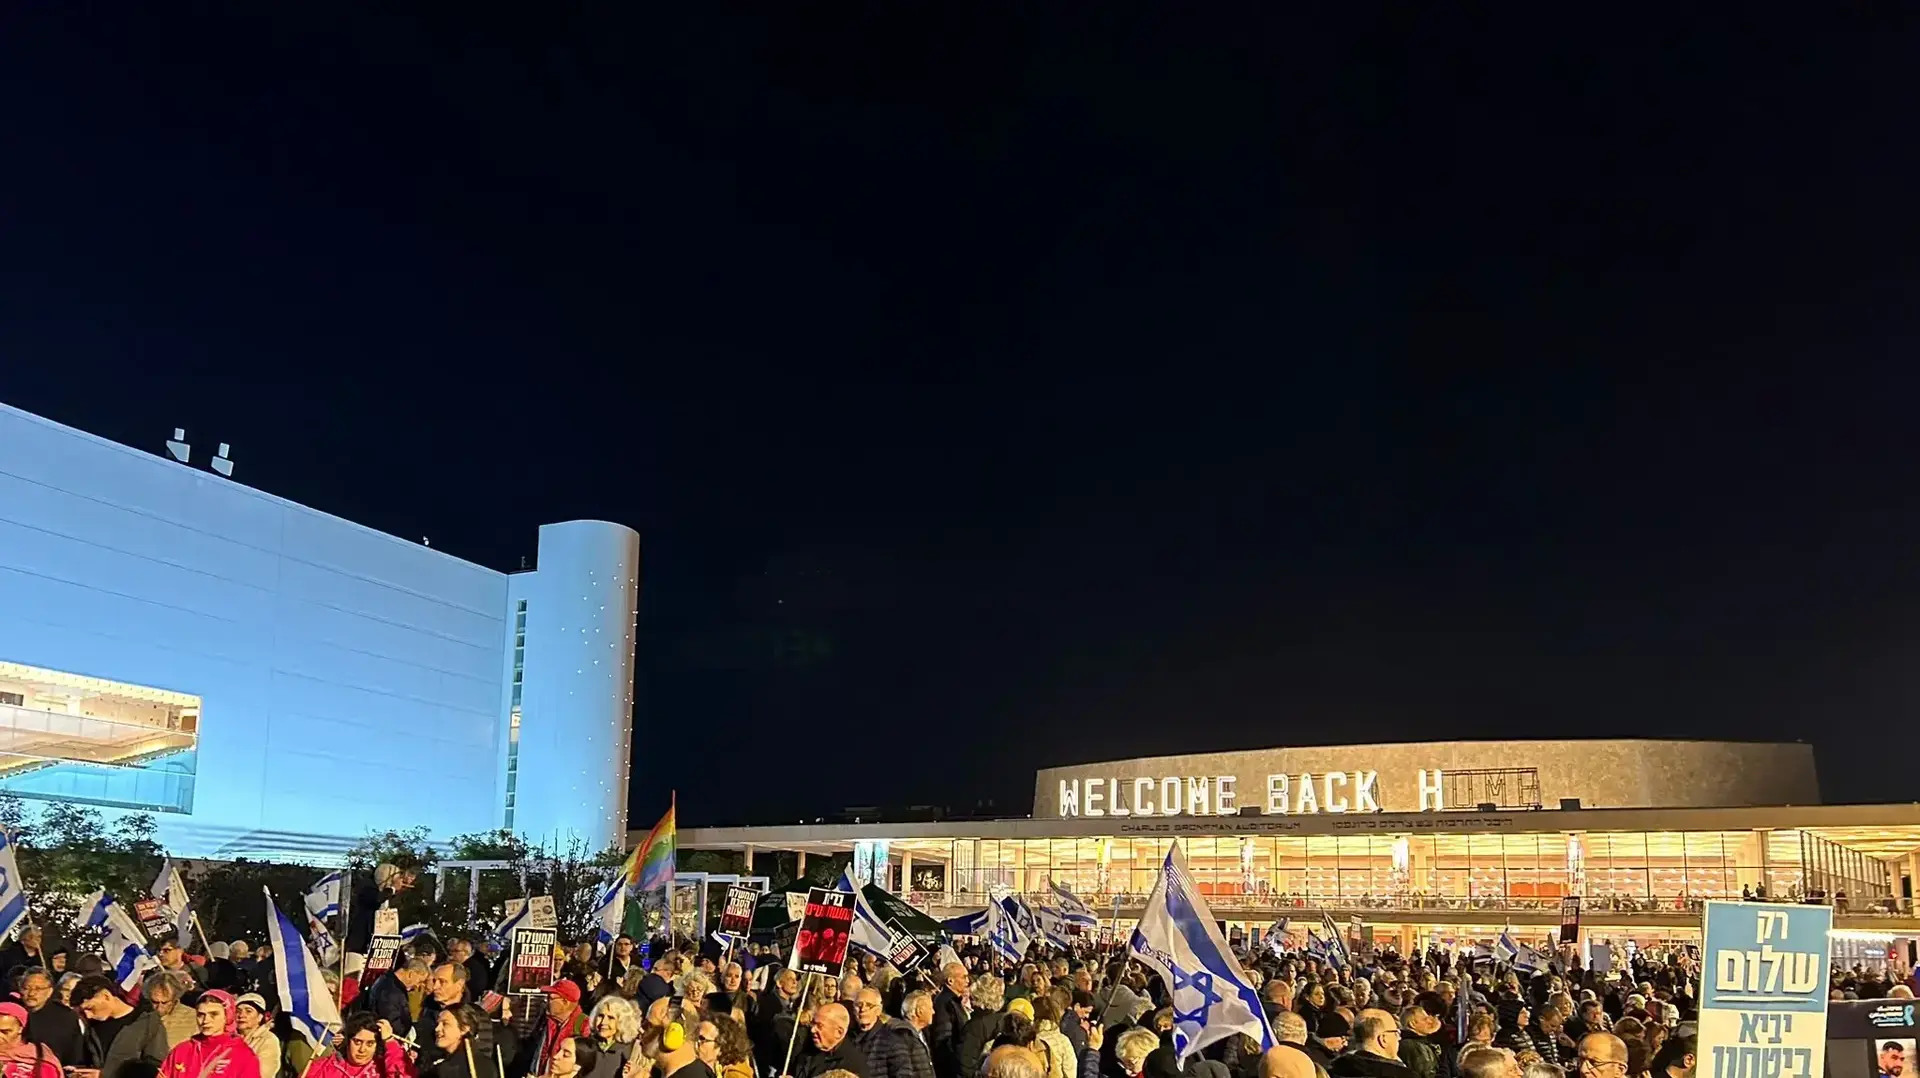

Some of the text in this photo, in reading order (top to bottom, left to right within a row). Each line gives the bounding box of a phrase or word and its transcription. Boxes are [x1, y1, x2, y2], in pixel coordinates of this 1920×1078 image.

[1060, 768, 1539, 817] WELCOME BACK HOME
[1121, 822, 1301, 832] CHARLES BRONFMAN AUDITORIUM
[728, 888, 756, 902] ממשלת
[730, 897, 751, 909] הטבח
[1756, 910, 1789, 944] רק
[372, 938, 399, 949] ממשלת
[517, 930, 554, 945] ממשלת
[373, 949, 394, 959] הטבח
[521, 943, 550, 956] הטבח
[1716, 944, 1820, 994] שלום
[1738, 1013, 1793, 1044] יביא
[1712, 1046, 1812, 1078] ביטחון
